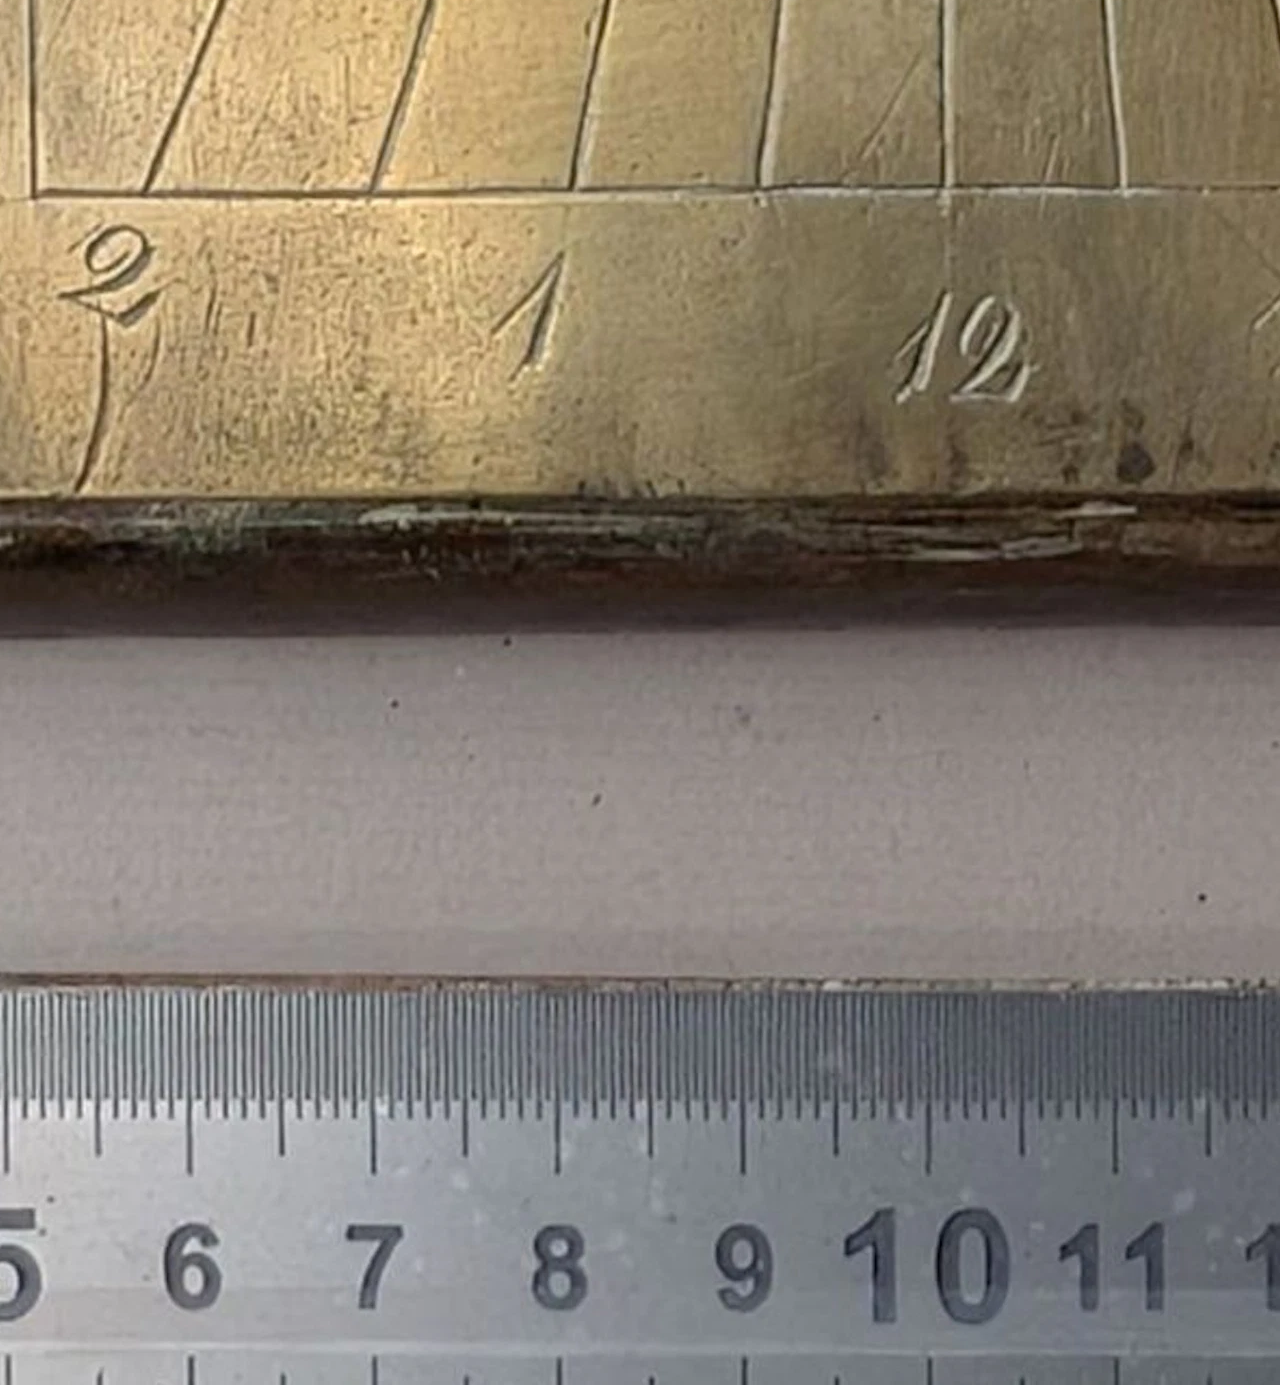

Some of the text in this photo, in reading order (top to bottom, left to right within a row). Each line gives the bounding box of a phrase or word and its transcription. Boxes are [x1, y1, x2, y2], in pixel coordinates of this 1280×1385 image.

[894, 289, 1040, 405] 12
[162, 1221, 222, 1312] 6
[343, 1223, 405, 1311] 7
[530, 1223, 588, 1312] 8
[714, 1223, 774, 1314] 9
[842, 1207, 1010, 1326] 10
[1058, 1222, 1165, 1311] 11
